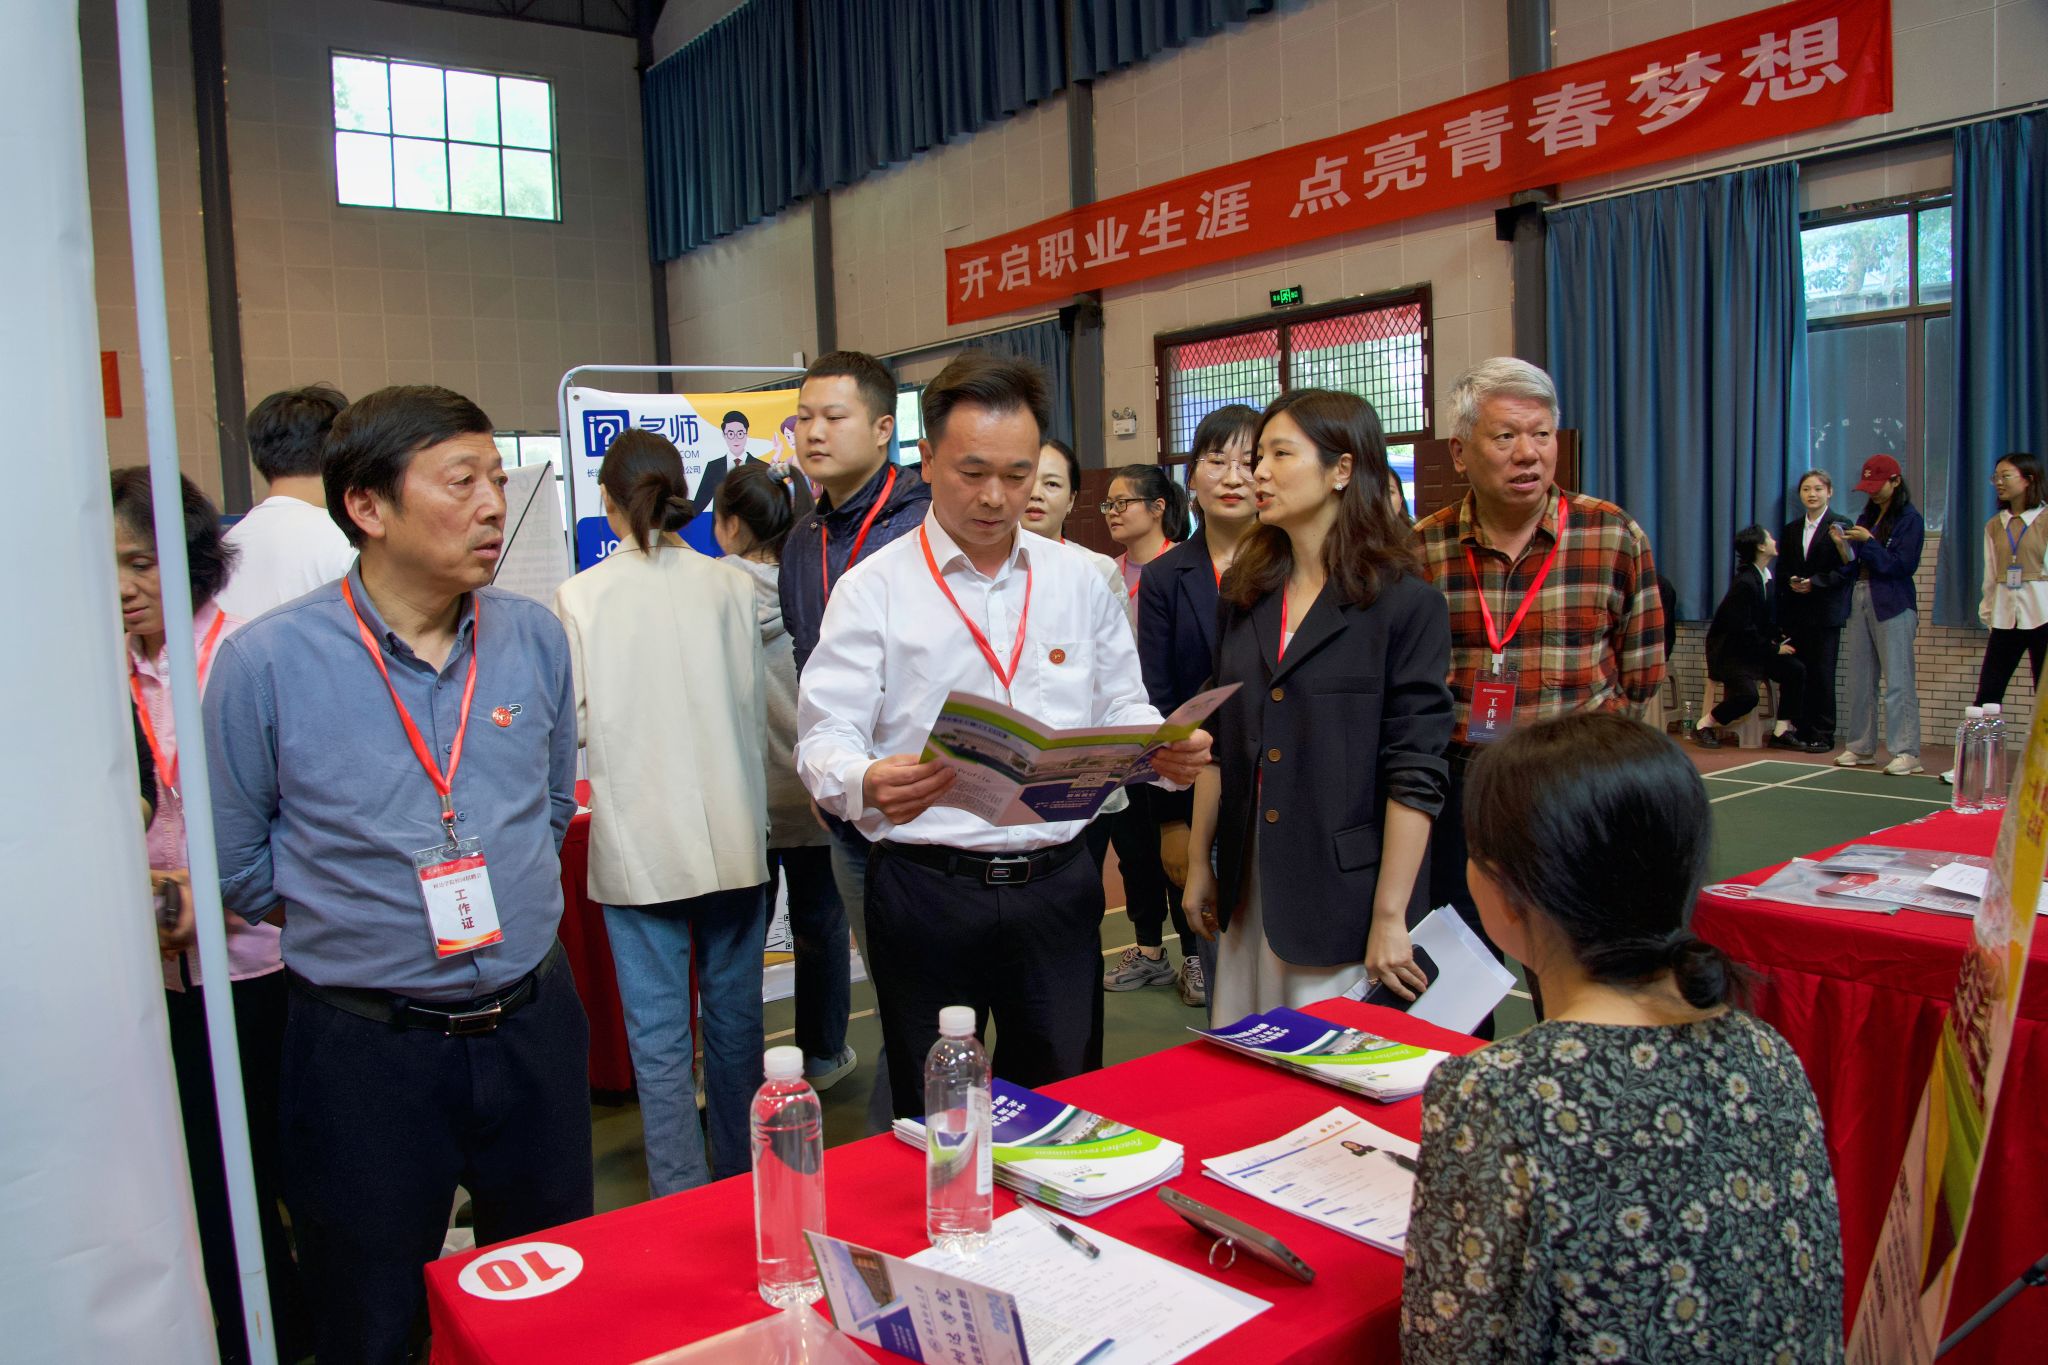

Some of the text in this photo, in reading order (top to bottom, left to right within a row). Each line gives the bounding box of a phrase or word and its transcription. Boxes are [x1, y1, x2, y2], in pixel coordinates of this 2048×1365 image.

[958, 17, 1848, 302] 开启职业生涯 点亮青春梦想
[1485, 697, 1499, 730] 工作证
[454, 888, 476, 931] 工作证
[1101, 1138, 1143, 1153] Teacher
[476, 1250, 566, 1292] 10
